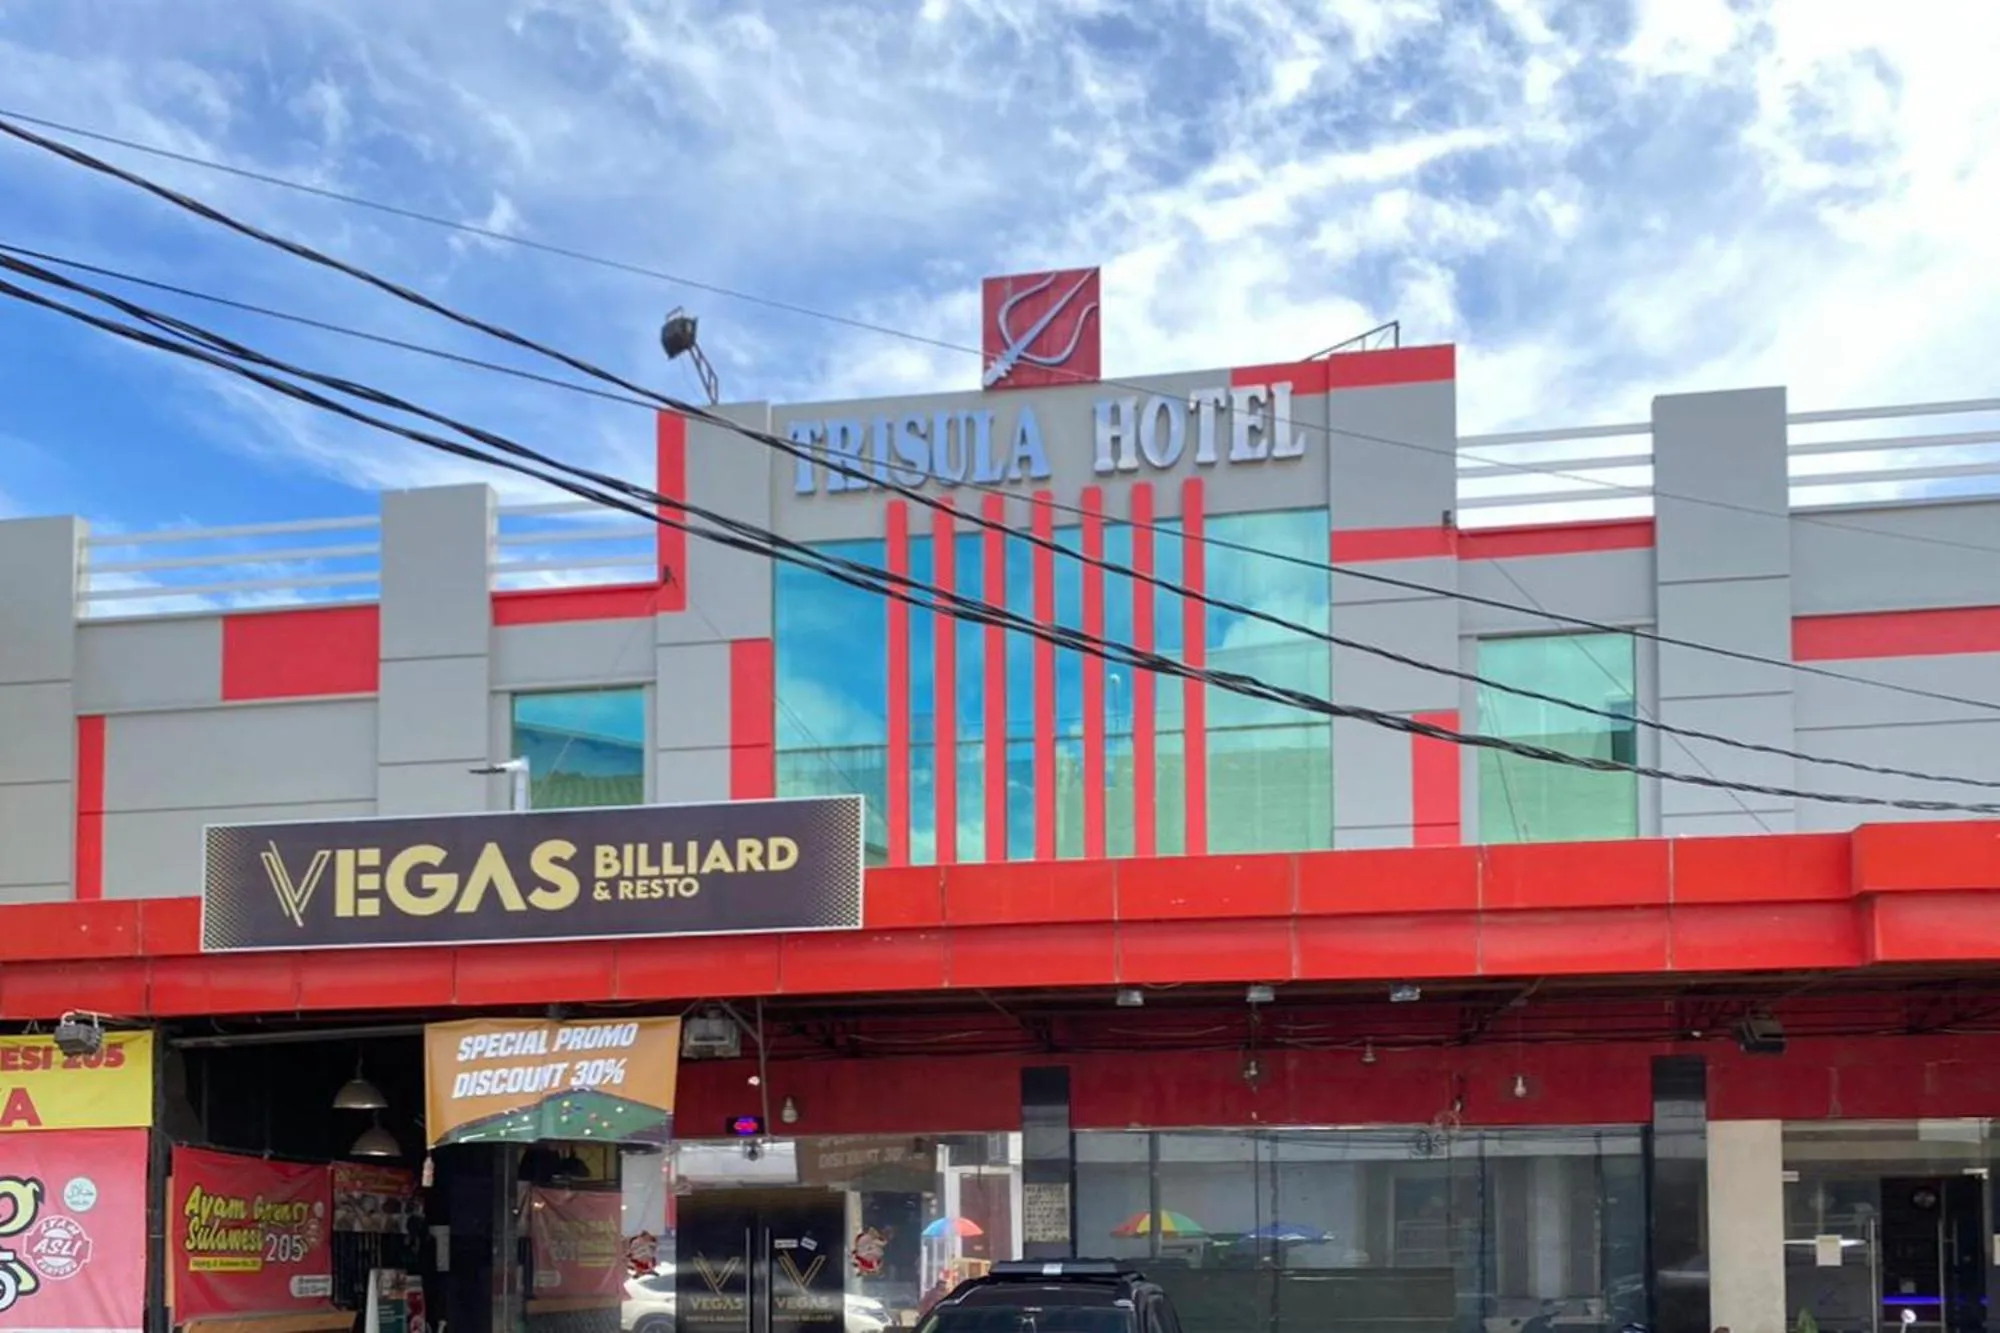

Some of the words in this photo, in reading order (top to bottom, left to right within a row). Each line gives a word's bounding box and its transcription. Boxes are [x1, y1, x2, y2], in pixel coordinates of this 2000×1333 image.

[789, 403, 1052, 496] TRISULA
[1093, 381, 1306, 473] HOTEL
[261, 838, 580, 927] VEGAS
[594, 837, 800, 879] BILLIARD
[593, 879, 611, 900] &
[618, 876, 700, 900] RESTO
[457, 1030, 548, 1061] SPECIAL
[552, 1023, 638, 1052] PROMO
[452, 1062, 568, 1099] DISCOUNT
[571, 1057, 628, 1087] 30%
[185, 1185, 248, 1226] Ayam
[33, 1238, 82, 1257] ASLI
[265, 1233, 304, 1262] 205
[691, 1297, 744, 1310] VEGAS
[775, 1297, 831, 1310] VEGAS
